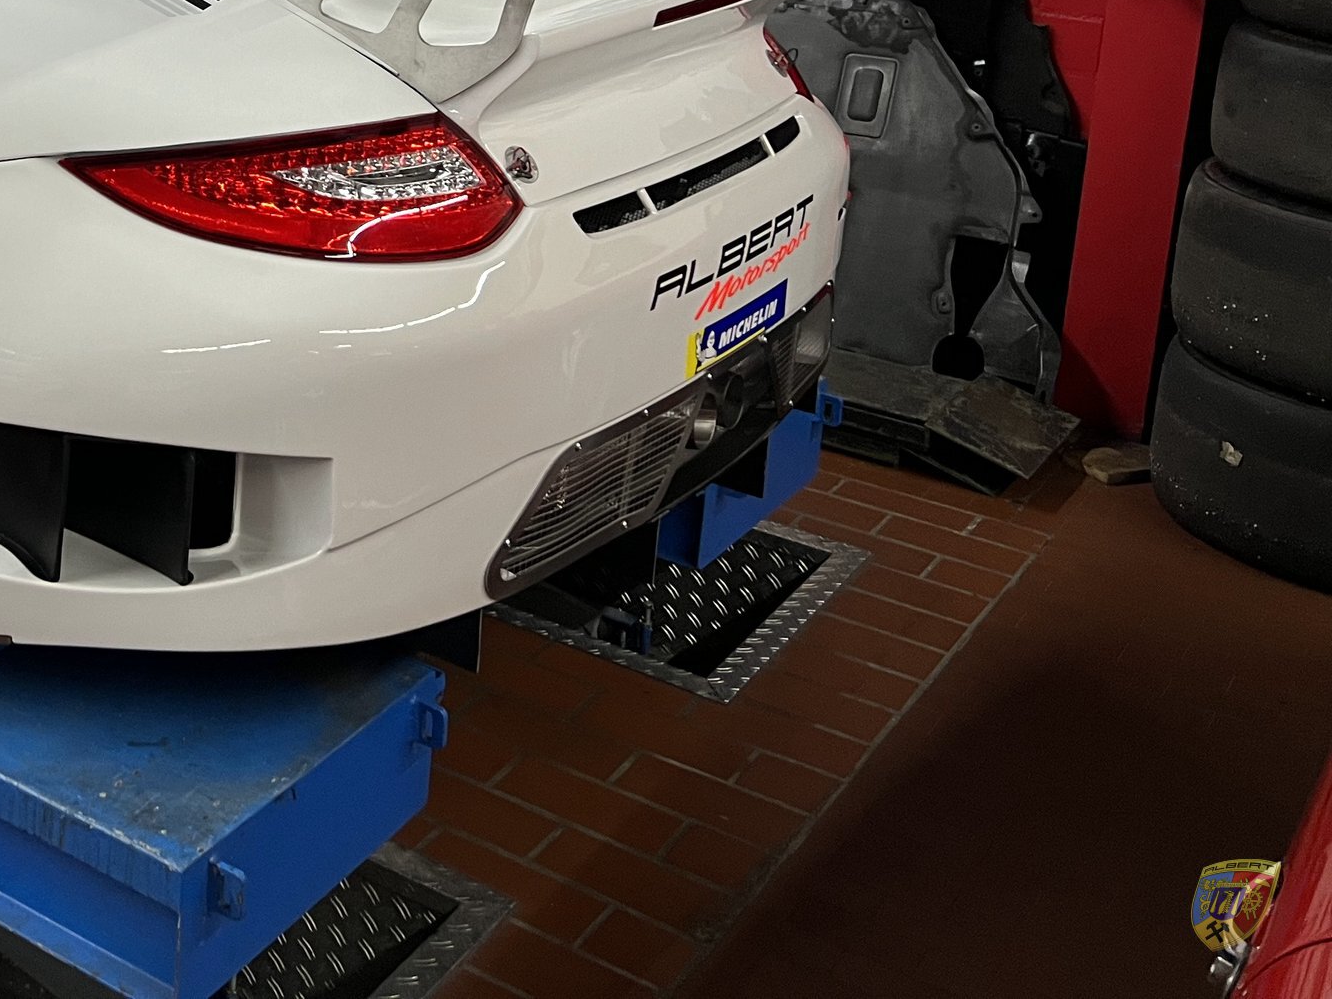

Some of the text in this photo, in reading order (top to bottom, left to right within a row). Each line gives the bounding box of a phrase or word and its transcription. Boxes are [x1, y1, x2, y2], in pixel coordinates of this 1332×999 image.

[650, 194, 814, 311] ALBERT
[694, 222, 810, 321] Motorsport
[718, 299, 778, 350] MICHELIN
